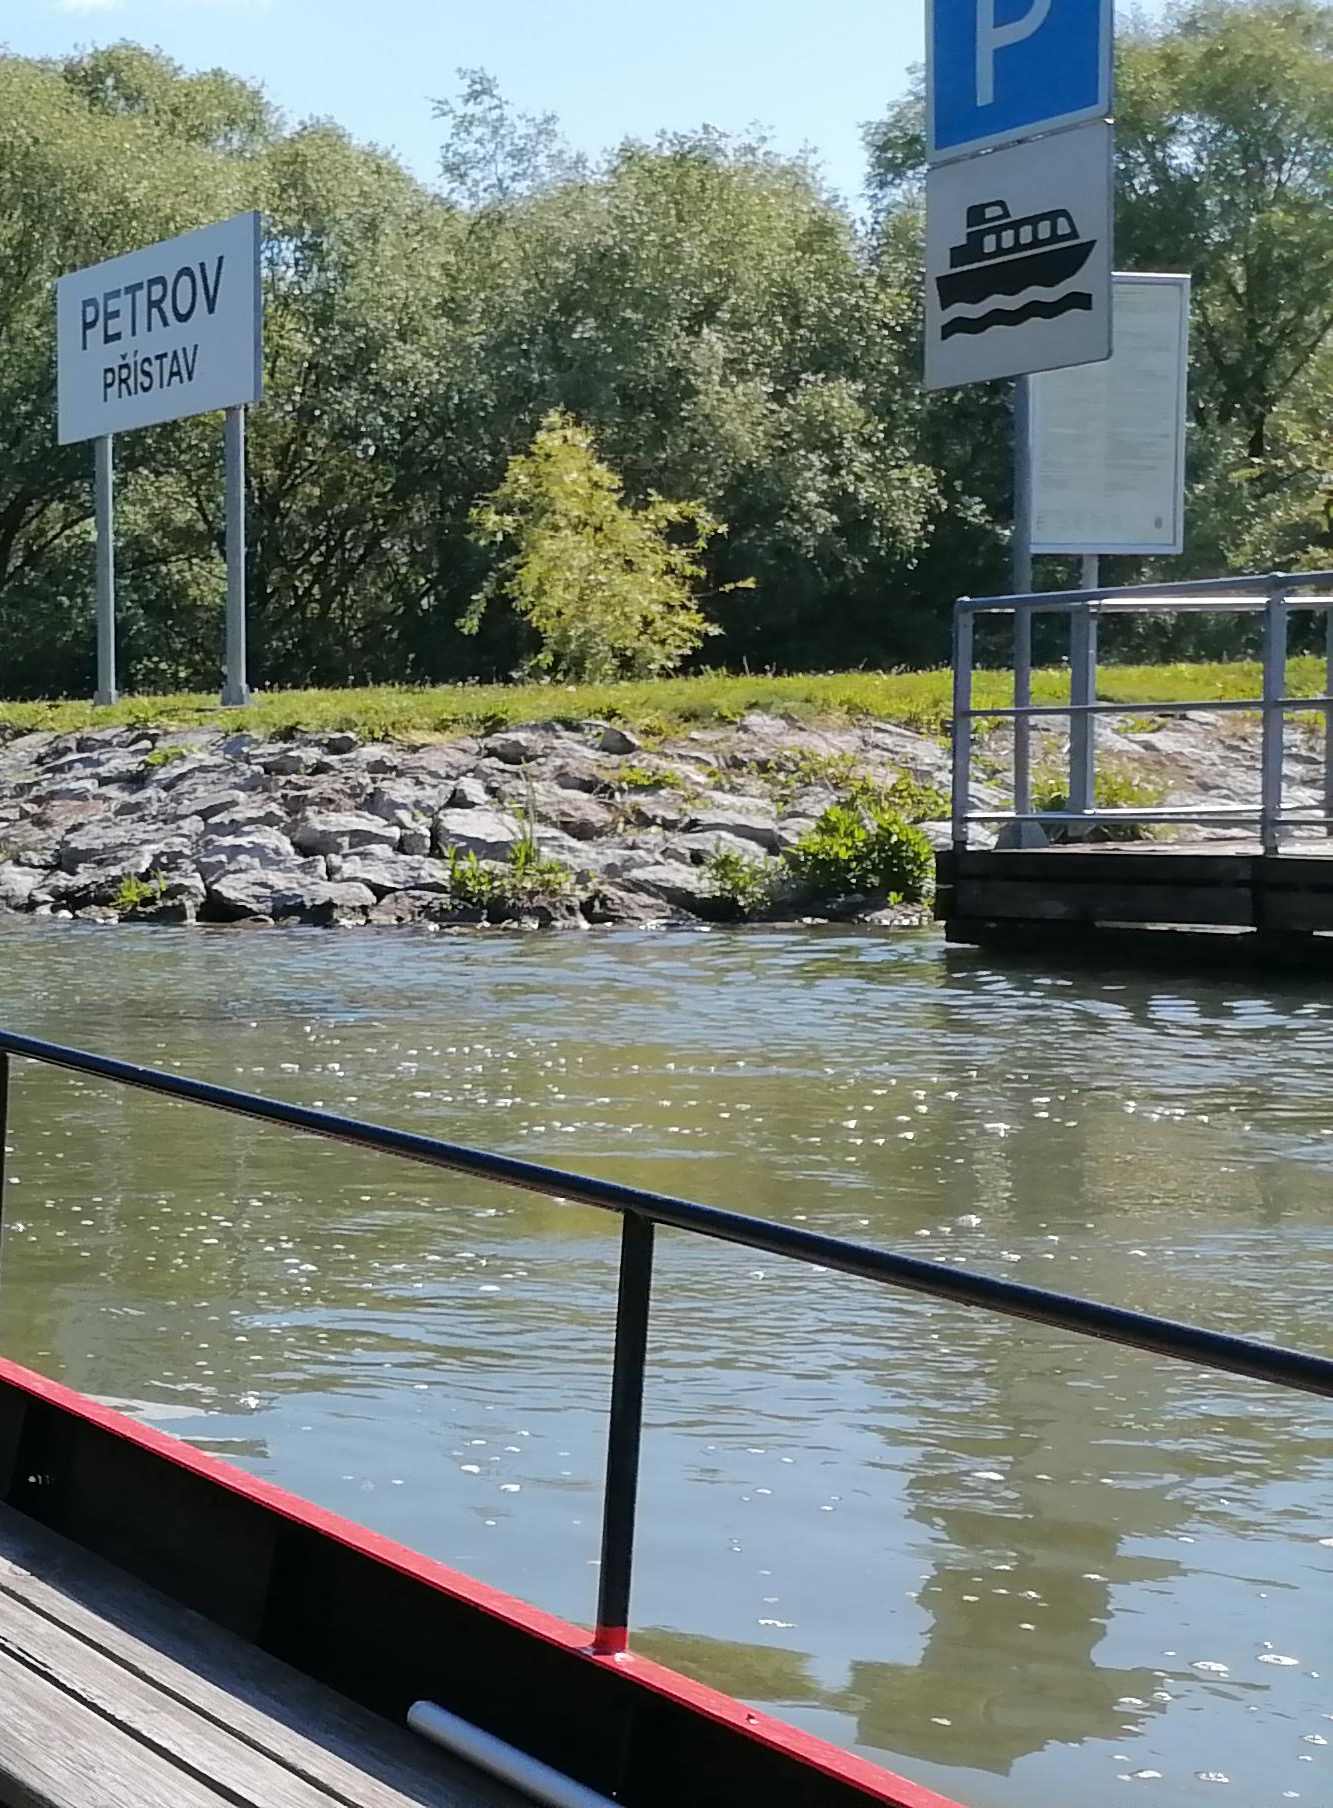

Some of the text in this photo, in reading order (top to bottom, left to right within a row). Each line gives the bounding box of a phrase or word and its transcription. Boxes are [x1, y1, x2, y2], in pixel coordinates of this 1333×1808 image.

[976, 0, 1052, 107] P
[81, 255, 225, 351] PETROV
[103, 344, 199, 402] PŘÍSTAV
